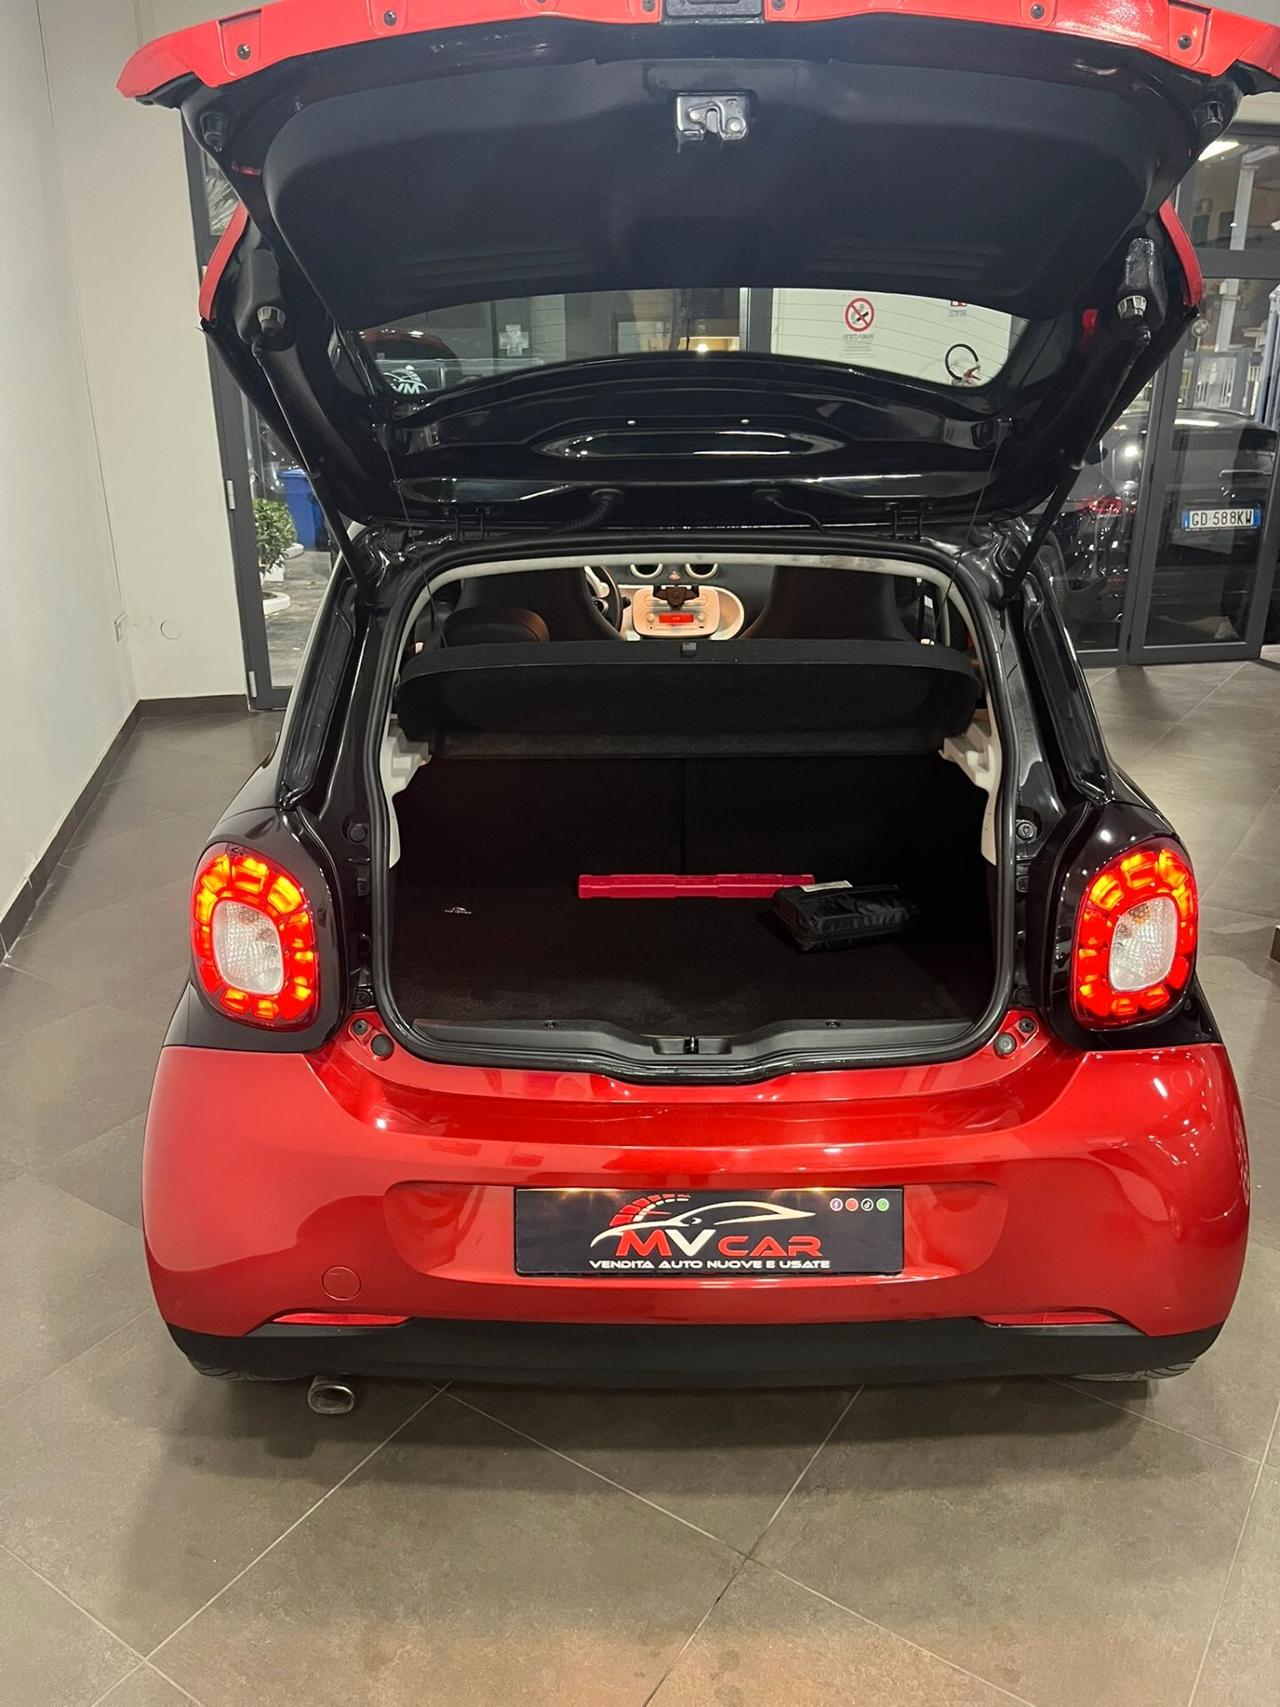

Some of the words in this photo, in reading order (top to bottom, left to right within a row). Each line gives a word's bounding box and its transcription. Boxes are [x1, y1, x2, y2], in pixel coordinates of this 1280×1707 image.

[1191, 511, 1208, 526] GD
[1212, 510, 1253, 525] 588KW
[616, 1229, 716, 1256] MV
[718, 1236, 822, 1256] CAR
[589, 1260, 654, 1269] VENDITA
[660, 1260, 702, 1269] AUTO
[707, 1260, 762, 1269] NUOVE
[766, 1260, 775, 1269] E
[779, 1260, 830, 1269] USATE
